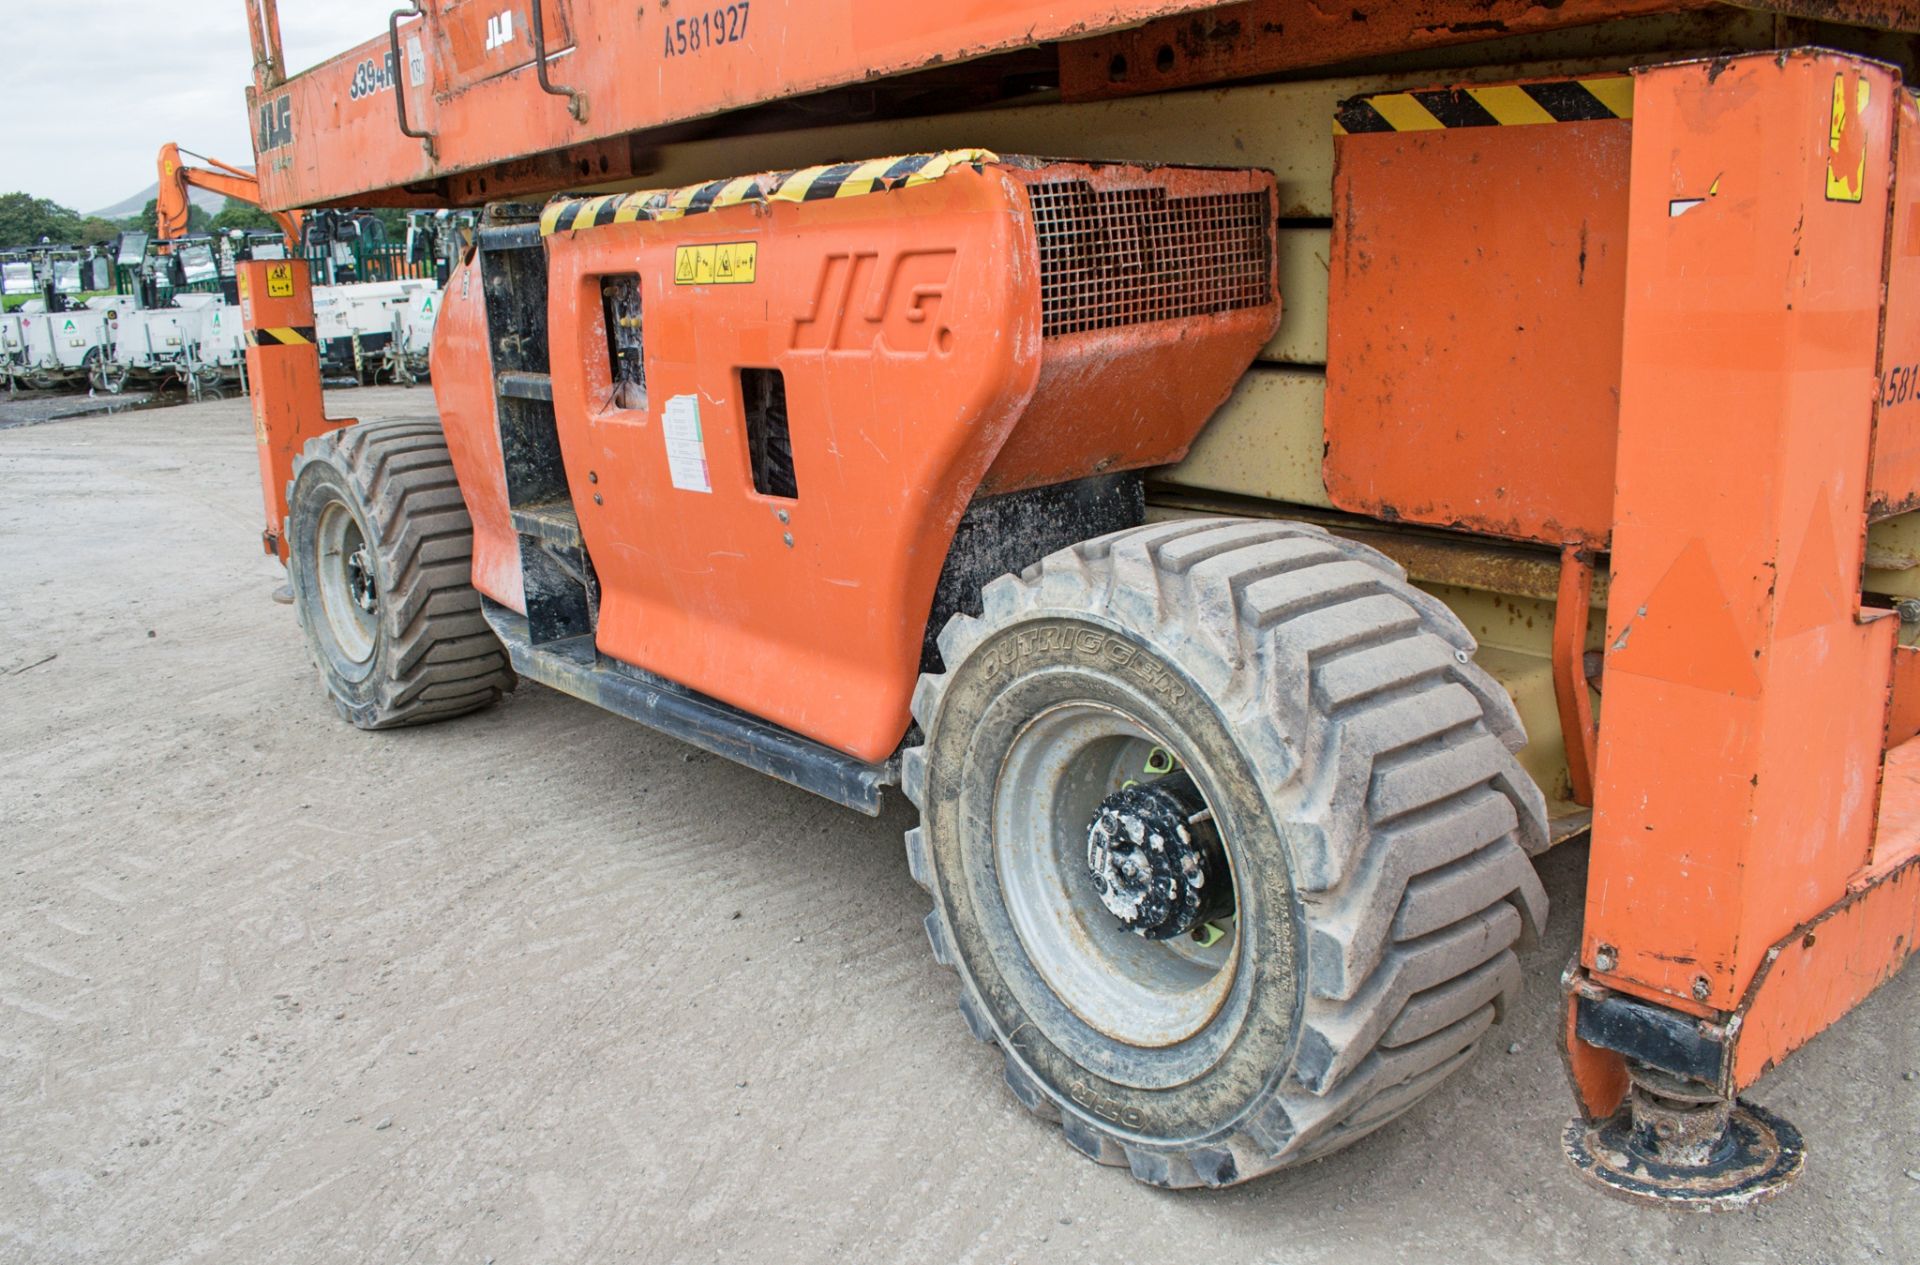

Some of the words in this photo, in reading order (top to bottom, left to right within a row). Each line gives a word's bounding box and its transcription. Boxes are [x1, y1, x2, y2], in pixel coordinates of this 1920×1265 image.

[664, 2, 750, 58] A581927
[259, 93, 292, 154] JLG
[788, 247, 957, 354] JLG
[981, 626, 1186, 705] OUTRIGGER
